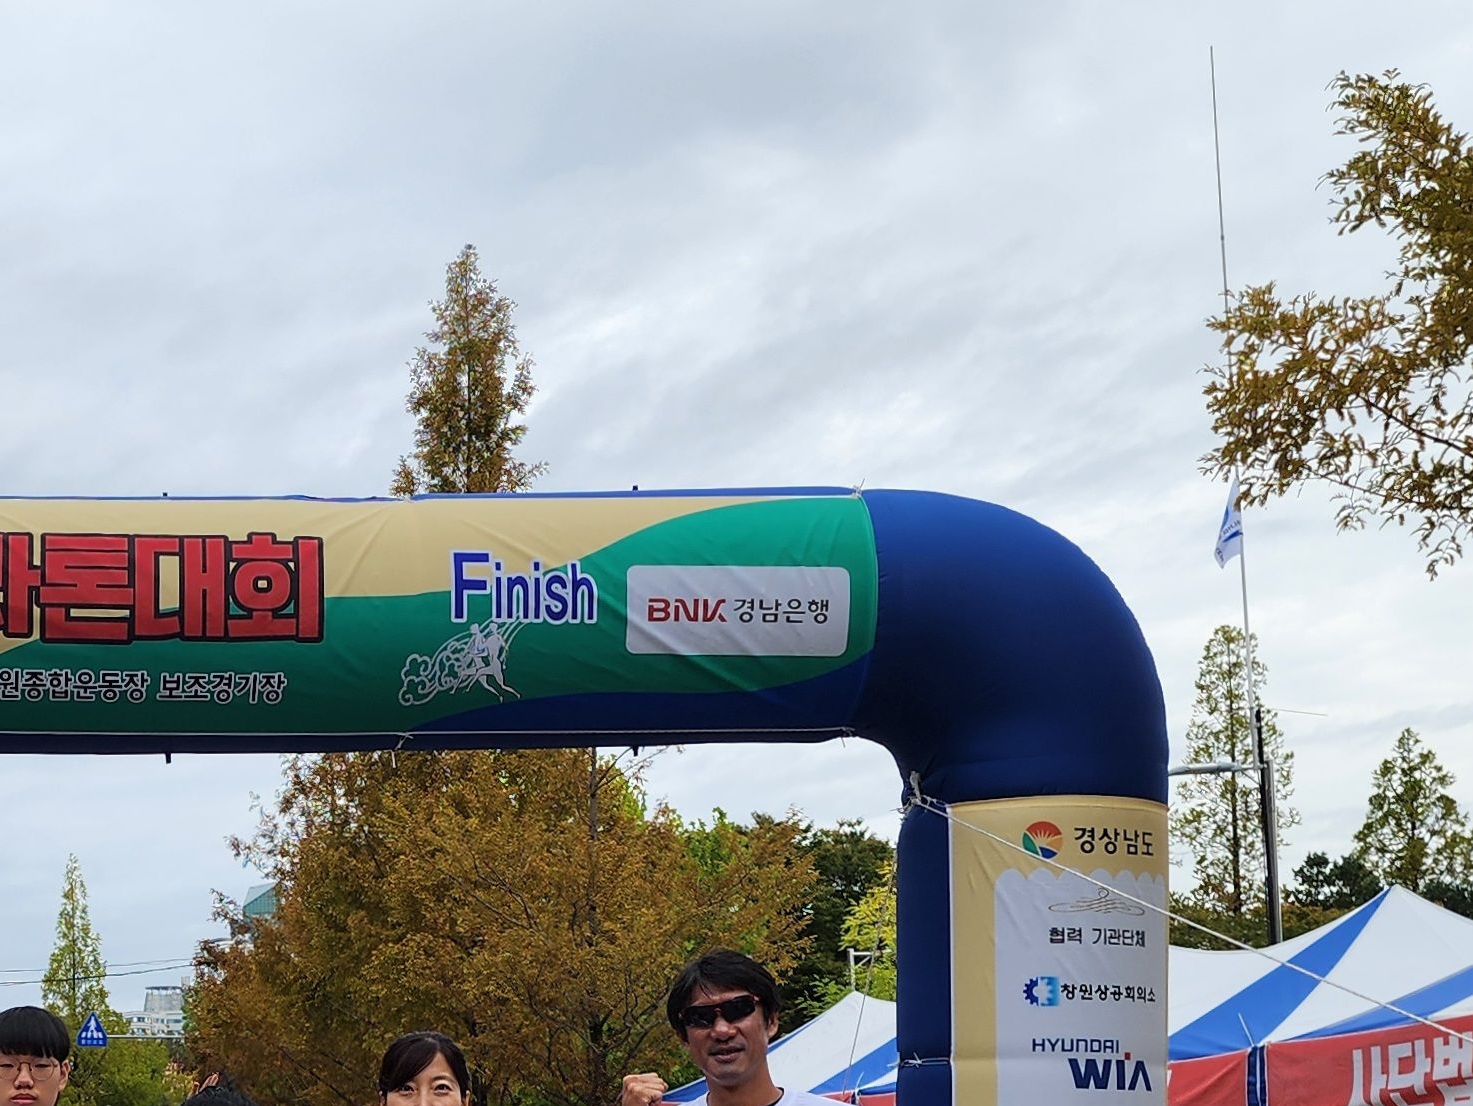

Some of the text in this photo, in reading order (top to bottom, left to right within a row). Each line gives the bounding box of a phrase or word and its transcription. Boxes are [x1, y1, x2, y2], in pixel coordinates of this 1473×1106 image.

[452, 551, 596, 623] Finish
[647, 598, 829, 624] BNK 경남은행
[157, 672, 286, 704] 보조경기장
[1074, 827, 1154, 856] 경상남도
[1049, 927, 1146, 947] 협력 기관단체
[1060, 983, 1156, 1003] 창원상공회의소
[1031, 1038, 1120, 1053] HYUNDAI
